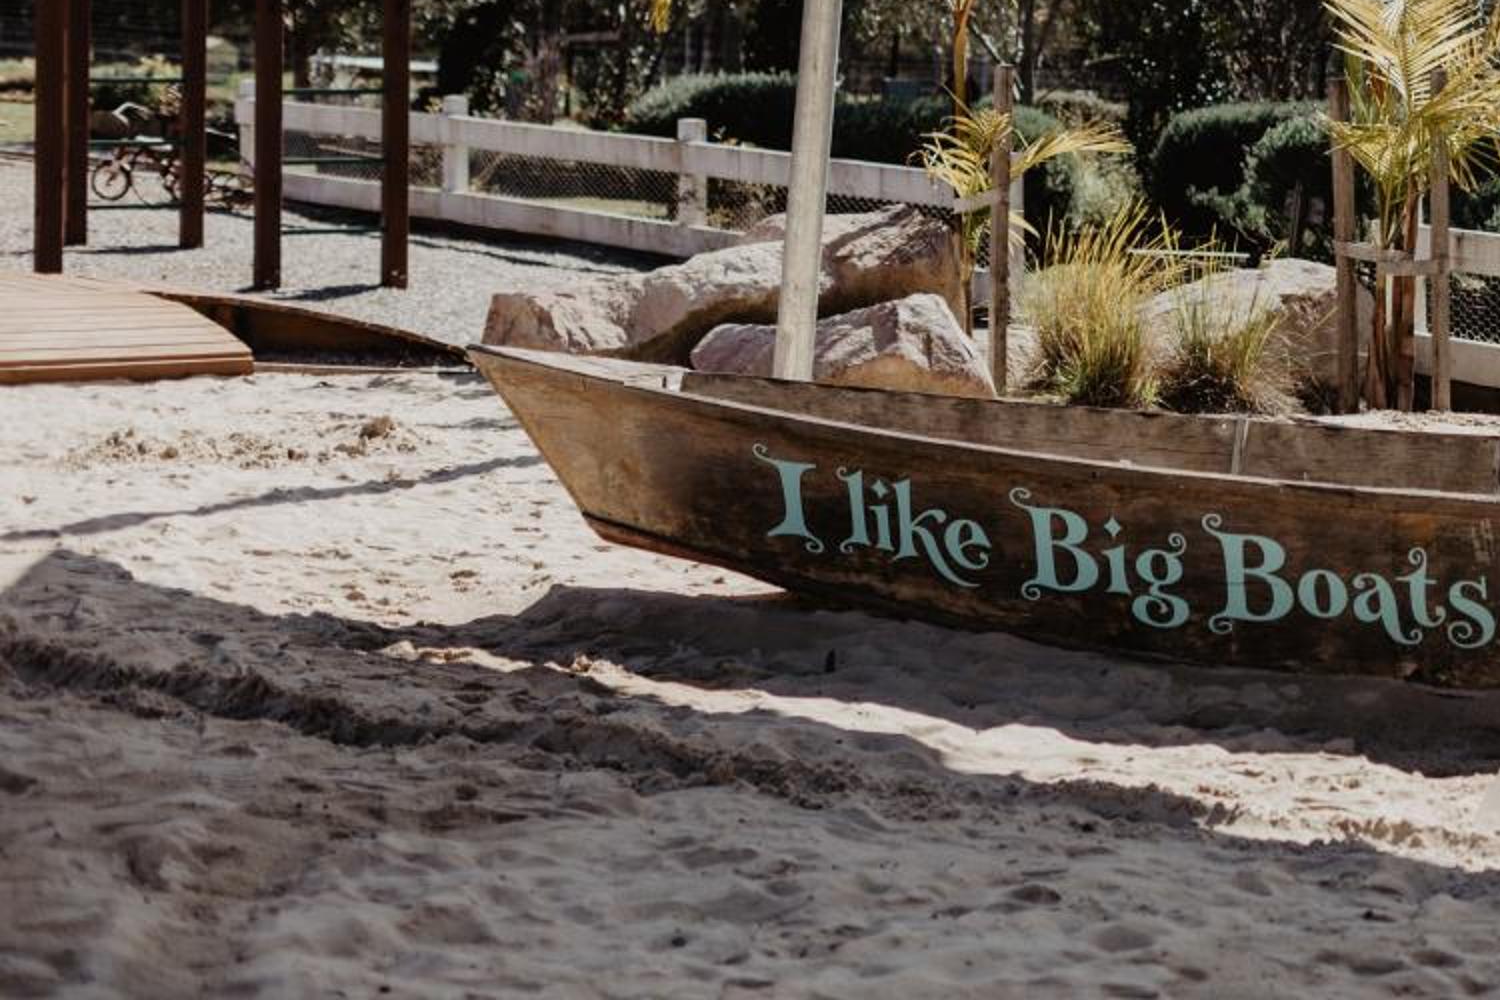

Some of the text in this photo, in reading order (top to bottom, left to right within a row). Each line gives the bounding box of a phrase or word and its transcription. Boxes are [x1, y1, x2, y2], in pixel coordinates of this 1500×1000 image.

[752, 443, 825, 554] I
[836, 466, 992, 587] like
[1009, 487, 1190, 628] Big
[1201, 513, 1496, 649] Boats
